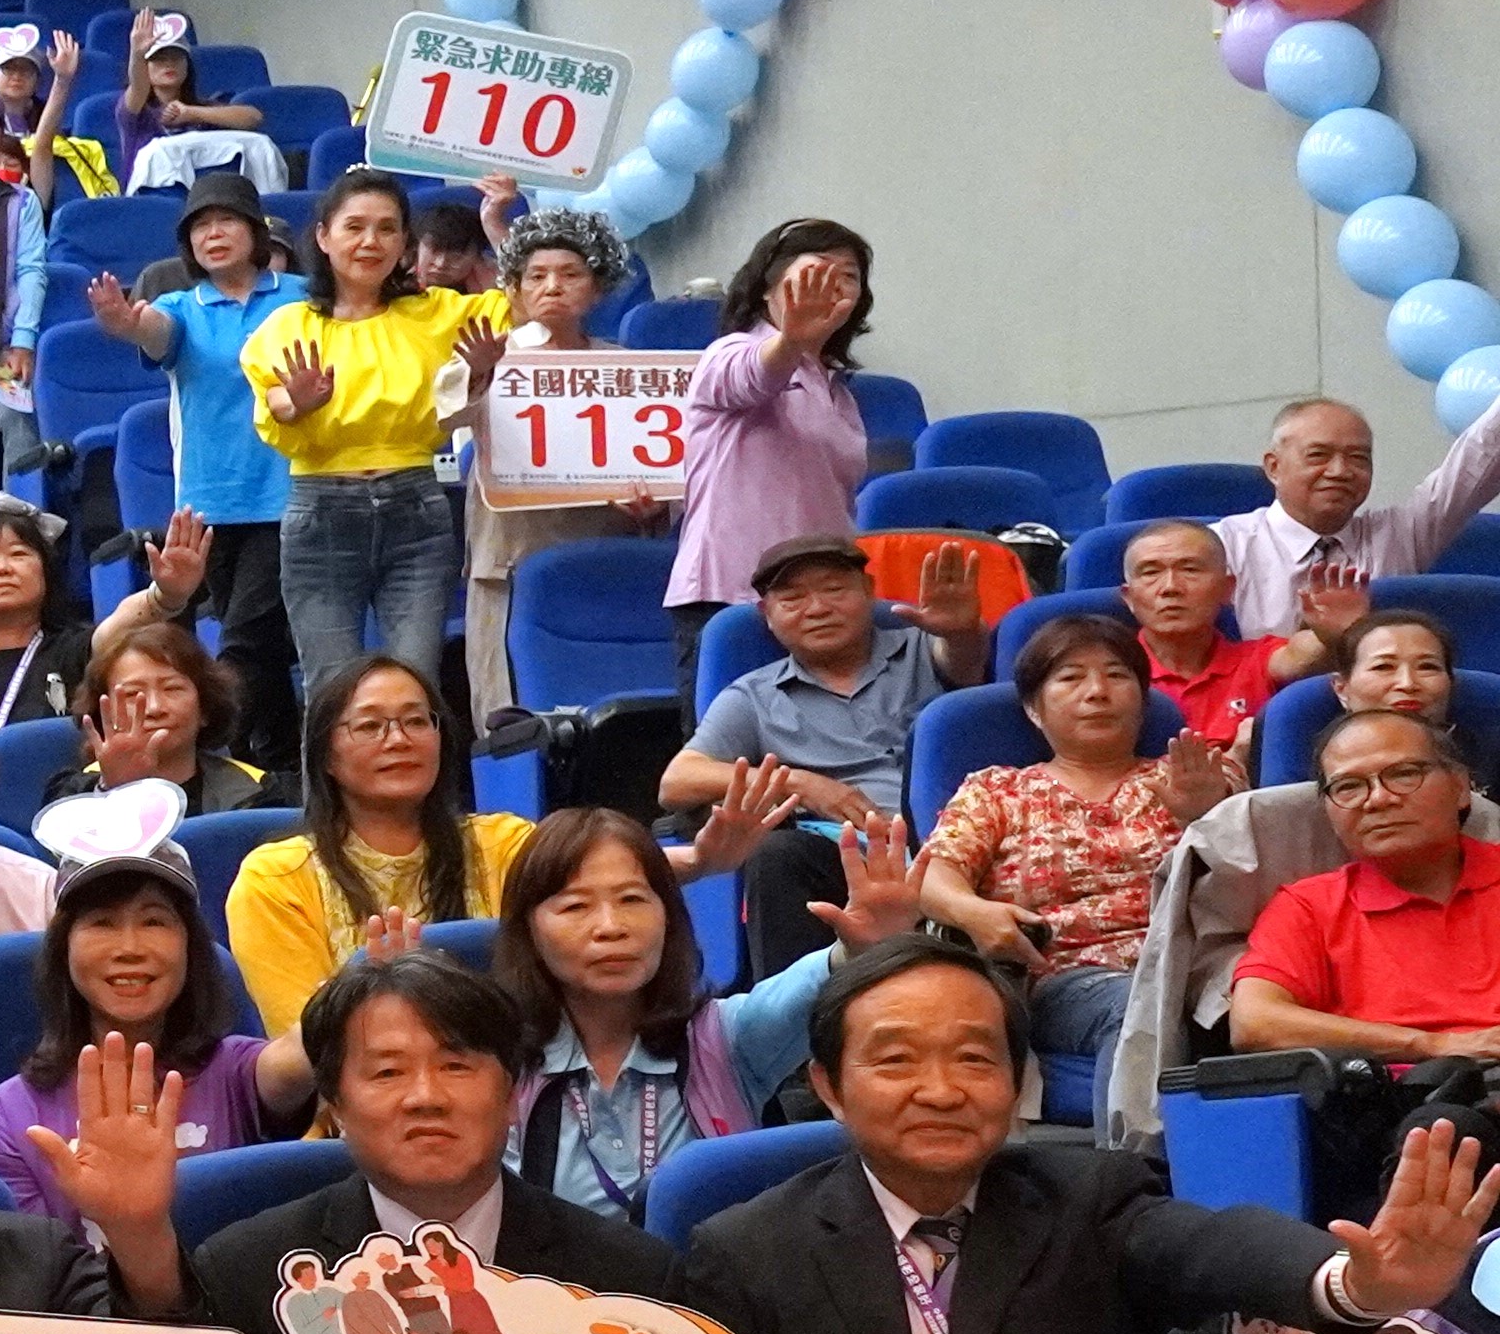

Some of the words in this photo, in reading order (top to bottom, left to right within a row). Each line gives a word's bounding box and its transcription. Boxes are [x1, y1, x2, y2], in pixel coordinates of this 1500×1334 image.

[412, 31, 613, 97] 緊急求助專線
[421, 72, 577, 159] 110
[517, 404, 684, 467] 113
